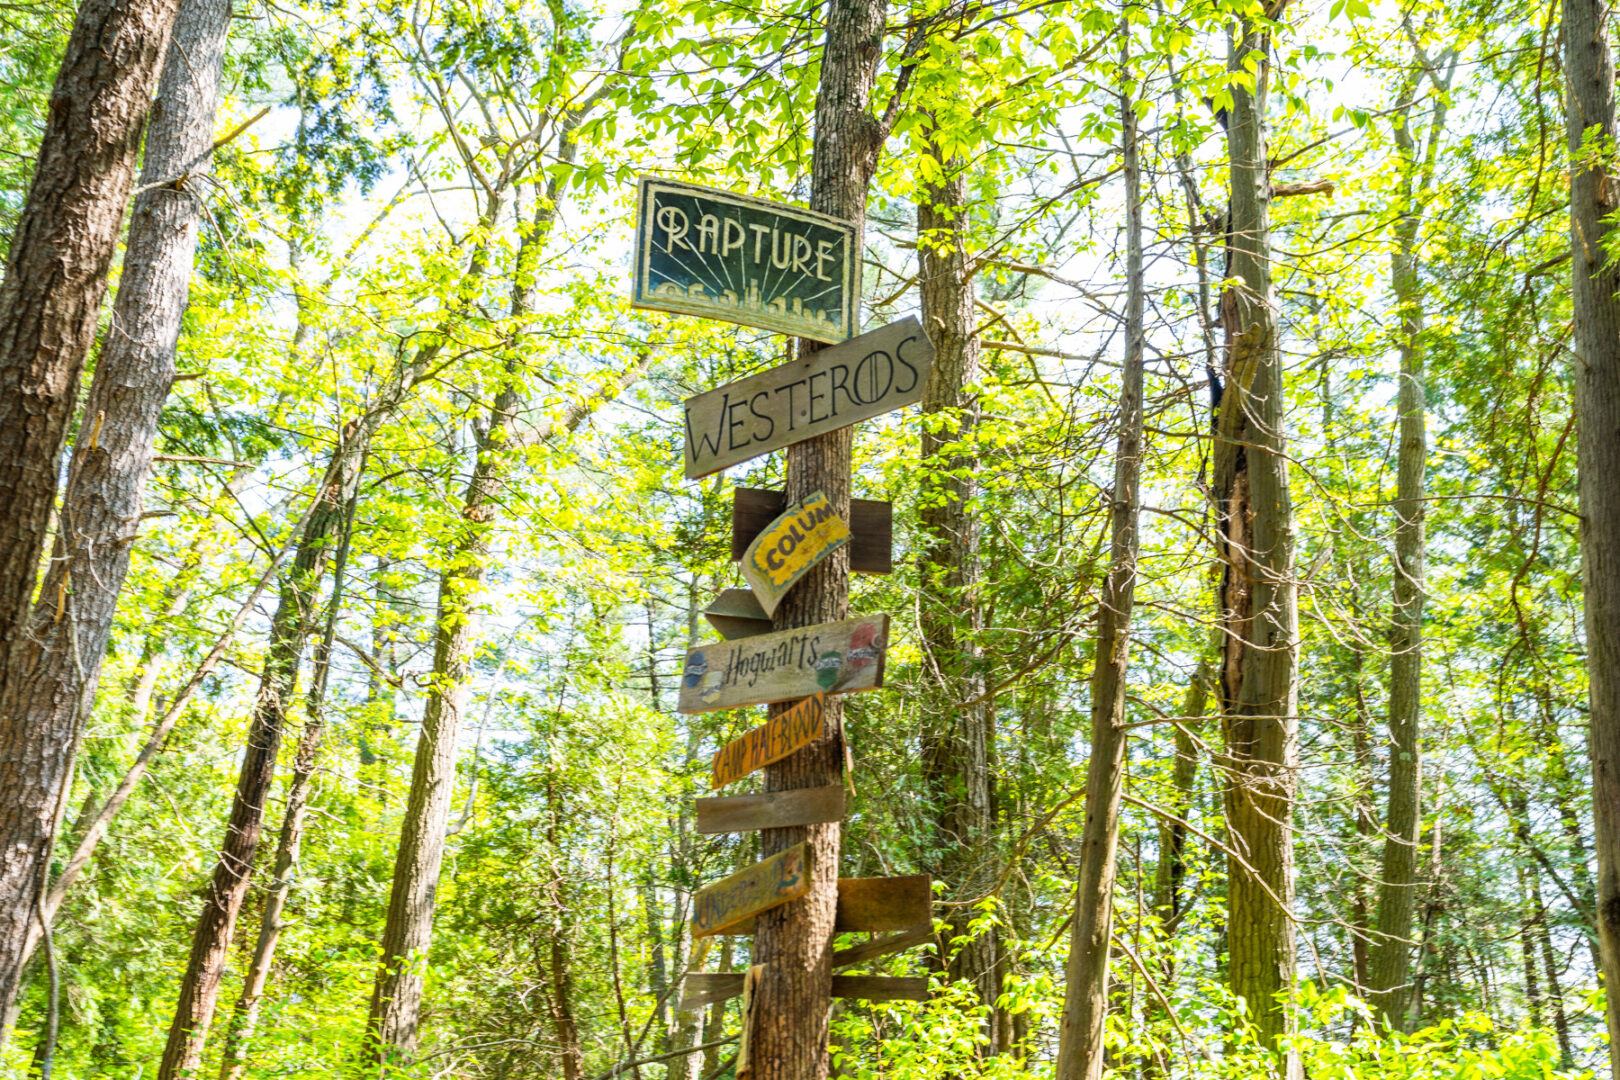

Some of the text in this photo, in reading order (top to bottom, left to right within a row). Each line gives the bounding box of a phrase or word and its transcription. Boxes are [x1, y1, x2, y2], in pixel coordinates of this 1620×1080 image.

[657, 206, 836, 282] RAPTURE
[685, 336, 919, 463] WESTEROS
[725, 635, 820, 686] Hogwarts
